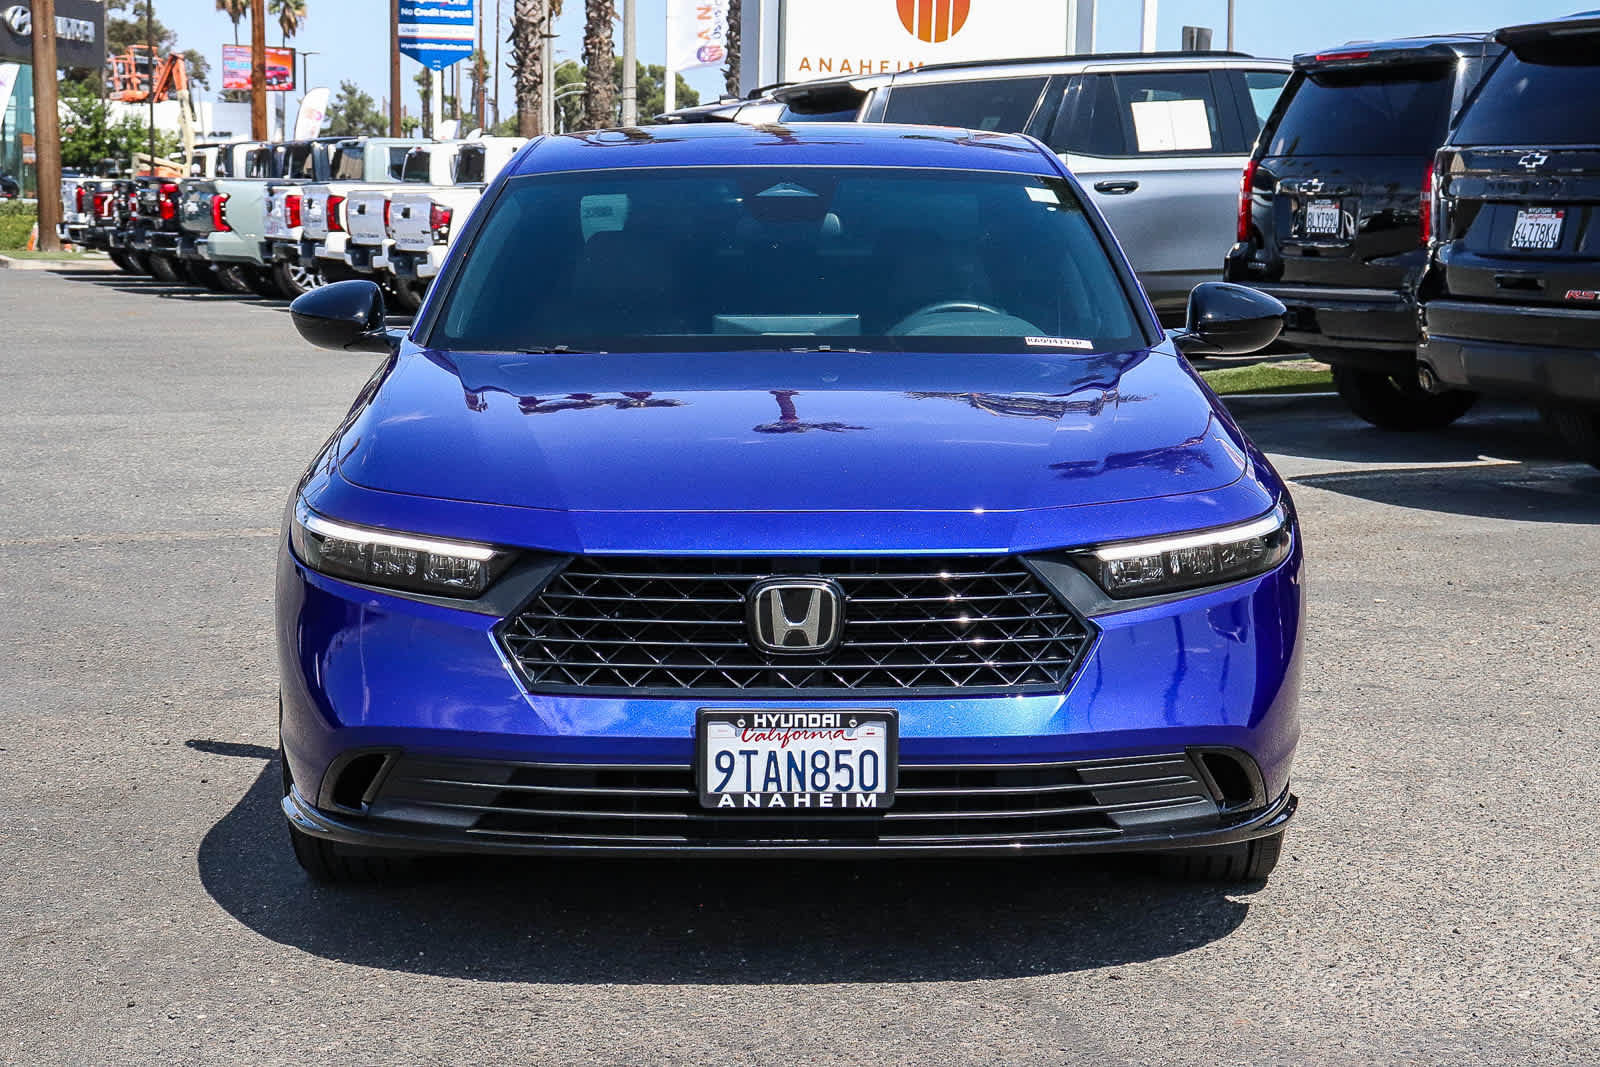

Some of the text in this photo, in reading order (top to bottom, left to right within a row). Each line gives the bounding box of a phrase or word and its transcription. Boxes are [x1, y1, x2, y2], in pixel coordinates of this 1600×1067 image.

[753, 713, 841, 728] HYUNDAI
[741, 727, 858, 748] California
[714, 749, 879, 793] 9TAN850
[717, 793, 878, 808] ANAHEIM
